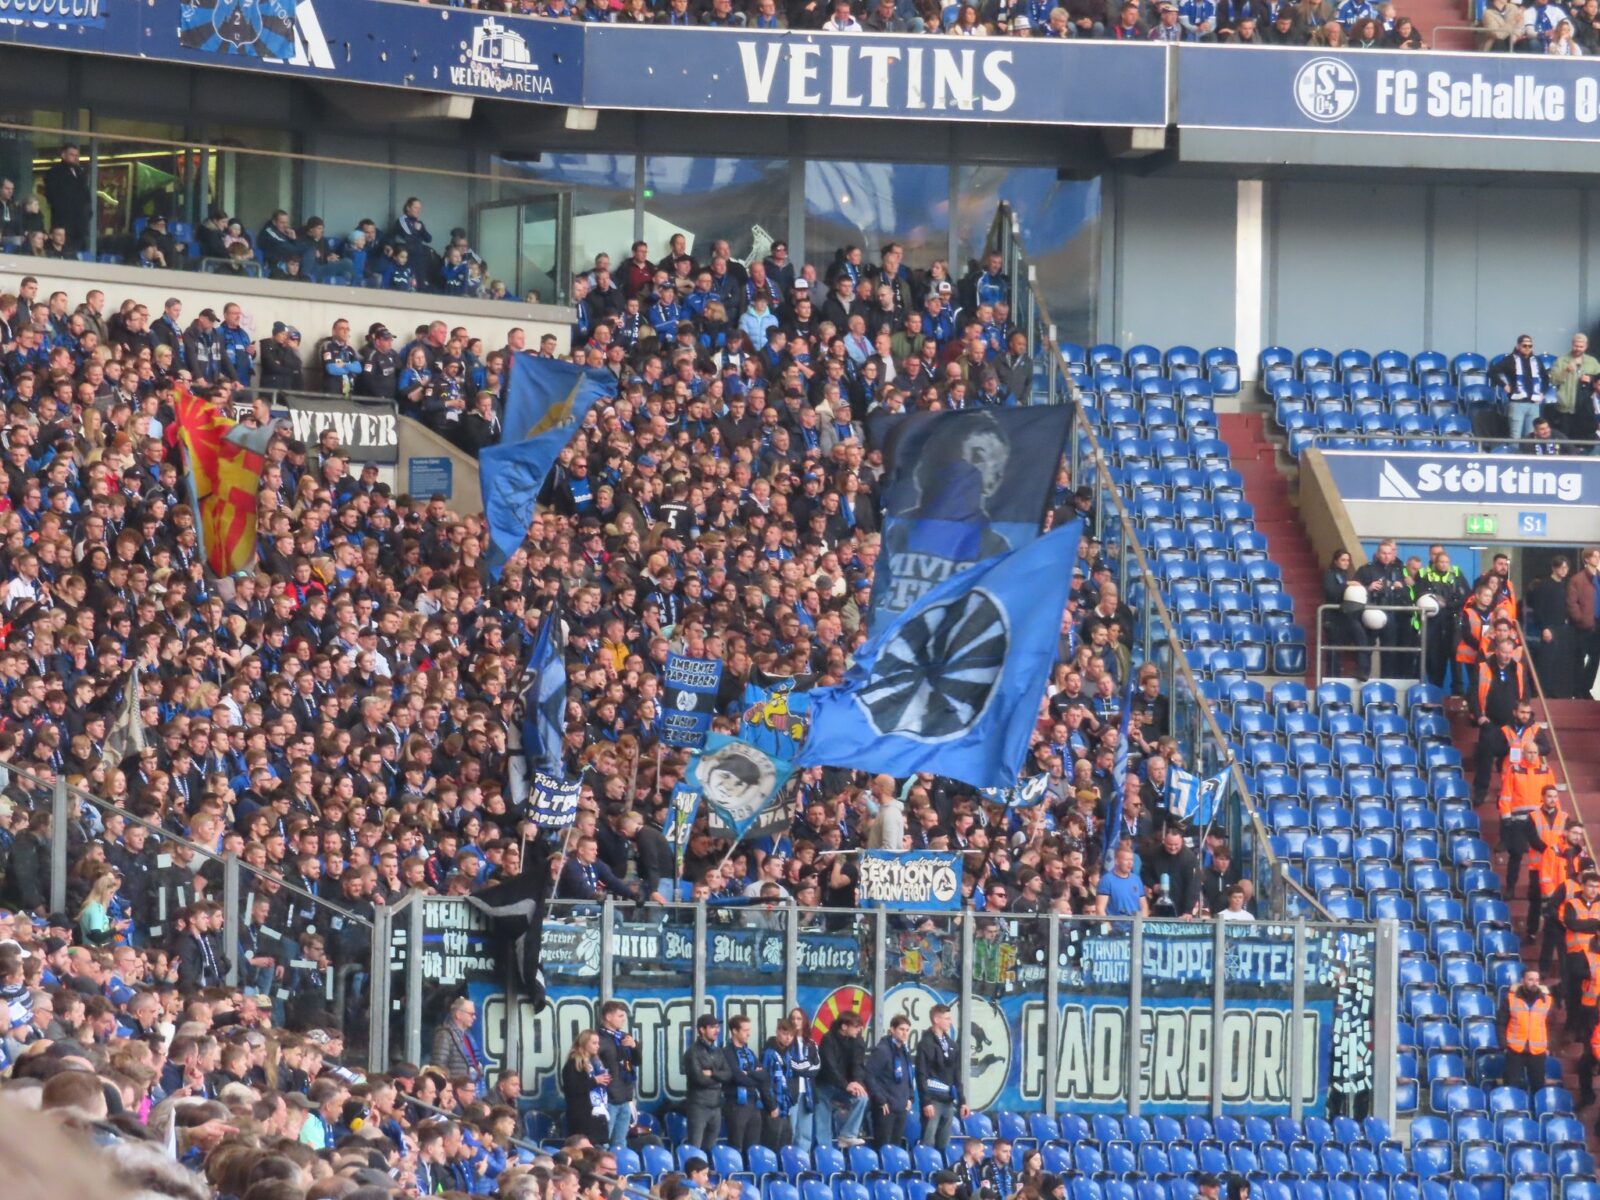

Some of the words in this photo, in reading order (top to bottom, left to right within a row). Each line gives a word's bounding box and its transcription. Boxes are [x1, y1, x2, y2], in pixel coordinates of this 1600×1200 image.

[737, 42, 1016, 112] VELTINS
[1376, 69, 1418, 116] FC
[1427, 71, 1565, 122] Schalke
[1575, 77, 1600, 123] 0
[289, 408, 398, 447] WEWER
[1417, 462, 1582, 501] Stölting
[1523, 516, 1542, 532] S1
[669, 657, 717, 674] AMBIENTE
[860, 862, 933, 885] SEKTION
[713, 935, 752, 964] Blue
